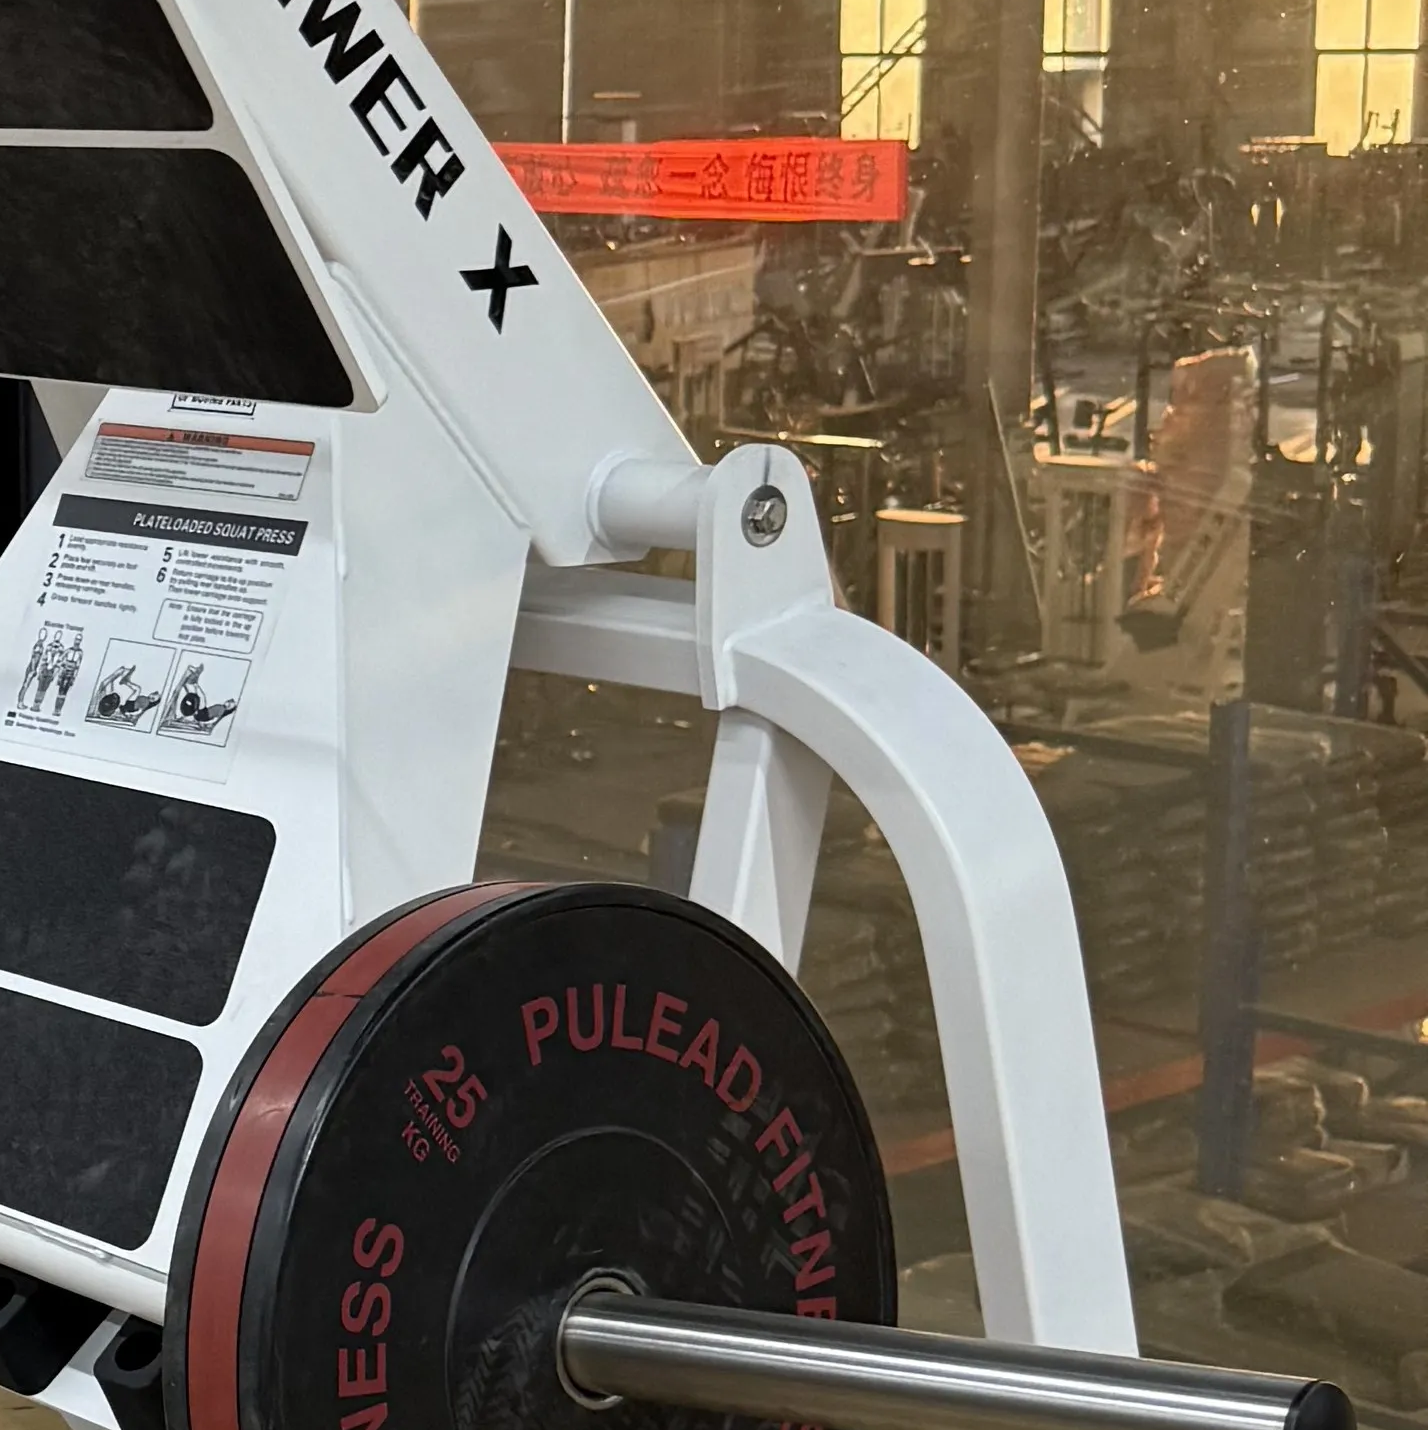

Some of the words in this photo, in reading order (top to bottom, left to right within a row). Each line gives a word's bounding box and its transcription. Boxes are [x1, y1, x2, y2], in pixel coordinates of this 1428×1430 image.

[459, 222, 540, 336] X
[58, 533, 66, 549] 1
[133, 512, 213, 536] PLATELOADED
[213, 520, 256, 541] SQUAT
[255, 527, 296, 545] PRESS
[48, 552, 59, 569] 2
[162, 546, 174, 562] 5
[43, 572, 53, 587] 3
[156, 566, 167, 583] 6
[37, 591, 47, 607] 4
[521, 983, 763, 1113] PULEAD
[422, 1044, 488, 1128] 25
[404, 1078, 461, 1164] TRAINING
[401, 1121, 430, 1162] KG
